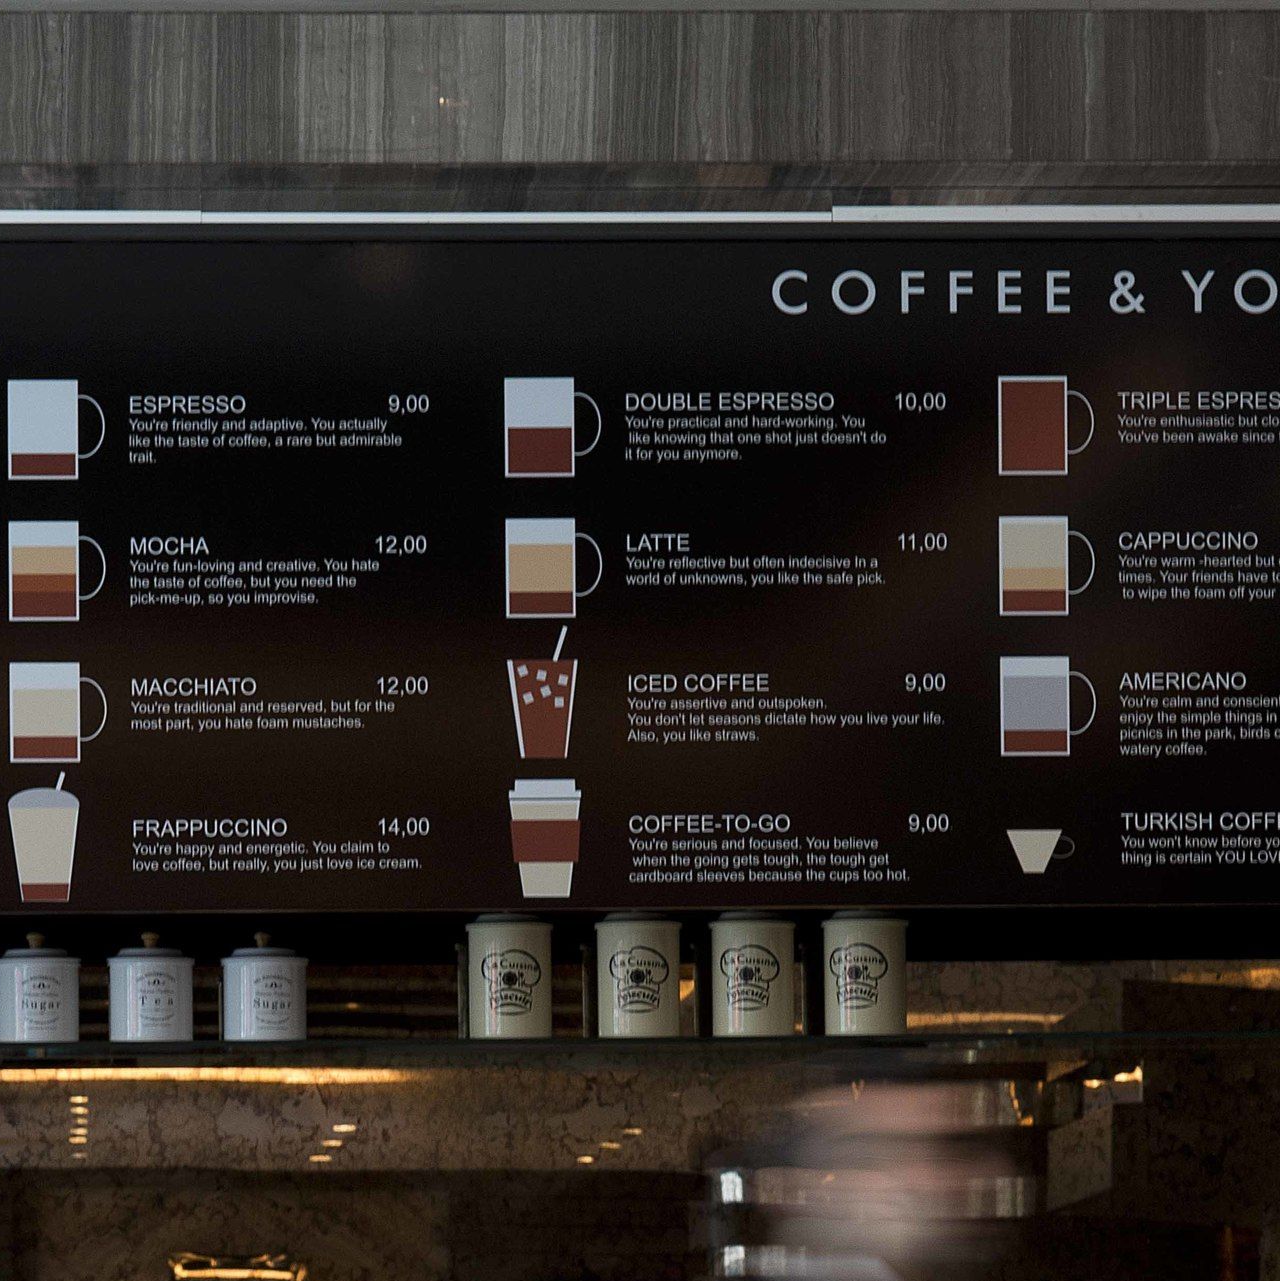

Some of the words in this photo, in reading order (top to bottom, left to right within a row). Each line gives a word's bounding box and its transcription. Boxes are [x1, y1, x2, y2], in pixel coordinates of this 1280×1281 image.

[771, 269, 1071, 315] COFFEE
[1108, 269, 1146, 315] &
[130, 395, 246, 414] ESPRESSO
[389, 395, 429, 414] 9,00
[626, 393, 711, 411] DOUBLE
[719, 392, 834, 410] ESPRESSO
[896, 393, 946, 412] 10,00
[1117, 392, 1190, 409] TRIPLE
[129, 418, 168, 431] You're
[172, 418, 218, 433] friendly
[222, 418, 246, 431] and
[311, 418, 335, 430] You
[339, 417, 387, 433] actually
[625, 416, 664, 428] You're
[668, 415, 721, 430] practical
[725, 415, 748, 428] and
[842, 415, 865, 428] You
[129, 435, 150, 447] like
[154, 434, 174, 447] the
[178, 435, 209, 447] taste
[212, 433, 225, 447] of
[275, 436, 283, 446] a
[287, 436, 312, 446] rare
[316, 434, 336, 446] but
[340, 433, 402, 446] admirable
[625, 448, 632, 460] it
[636, 447, 653, 460] for
[657, 450, 679, 462] you
[130, 537, 209, 555] MOCHA
[376, 535, 427, 555] 12,00
[627, 534, 690, 552] LATTE
[898, 533, 947, 552] 11,00
[1119, 532, 1258, 550] CAPPUCCINO
[208, 594, 223, 604] so
[227, 594, 250, 606] you
[132, 678, 256, 696] MACCHIATO
[377, 677, 428, 696] 12,00
[628, 675, 677, 692] ICED
[684, 674, 769, 692] COFFEE
[905, 673, 945, 692] 9,00
[1119, 672, 1246, 690] AMERICANO
[131, 701, 170, 714] You're
[174, 701, 236, 713] traditional
[240, 701, 263, 713] and
[331, 700, 350, 712] but
[355, 700, 371, 712] for
[375, 700, 395, 712] the
[627, 697, 666, 710] You're
[670, 697, 727, 710] assertive
[731, 697, 754, 709] and
[1120, 695, 1158, 708] You're
[1162, 695, 1192, 707] calm
[1196, 695, 1219, 707] and
[131, 718, 162, 730] most
[198, 719, 221, 731] you
[225, 717, 253, 729] hate
[257, 716, 288, 729] foam
[627, 713, 651, 726] You
[655, 713, 685, 726] don't
[689, 713, 704, 725] let
[709, 715, 761, 725] seasons
[765, 713, 806, 725] dictate
[810, 712, 836, 724] how
[840, 715, 862, 727] you
[867, 713, 888, 724] live
[892, 715, 919, 727] your
[1119, 711, 1153, 725] enjoy
[1157, 711, 1177, 723] the
[1181, 711, 1221, 725] simple
[1225, 710, 1262, 725] things
[1266, 712, 1277, 722] in
[663, 731, 686, 744] you
[690, 729, 711, 741] like
[1120, 726, 1163, 741] picnics
[1167, 727, 1177, 739] in
[1182, 727, 1201, 739] the
[1240, 726, 1270, 739] birds
[1120, 743, 1161, 757] watery
[133, 818, 287, 837] FRAPPUCCINO
[379, 818, 429, 837] 14,00
[629, 814, 790, 833] COFFEE-TO-GO
[909, 814, 949, 833] 9,00
[1121, 813, 1212, 831] TURKISH
[133, 842, 171, 855] You're
[176, 842, 214, 856] happy
[219, 842, 242, 854] and
[313, 841, 336, 853] You
[341, 841, 374, 853] claim
[378, 841, 390, 853] to
[133, 859, 159, 871] love
[209, 858, 229, 870] but
[274, 860, 296, 872] you
[300, 858, 323, 872] just
[327, 857, 353, 869] love
[357, 857, 375, 869] ice
[138, 995, 174, 1007] Tea
[253, 998, 291, 1012] Sugar
